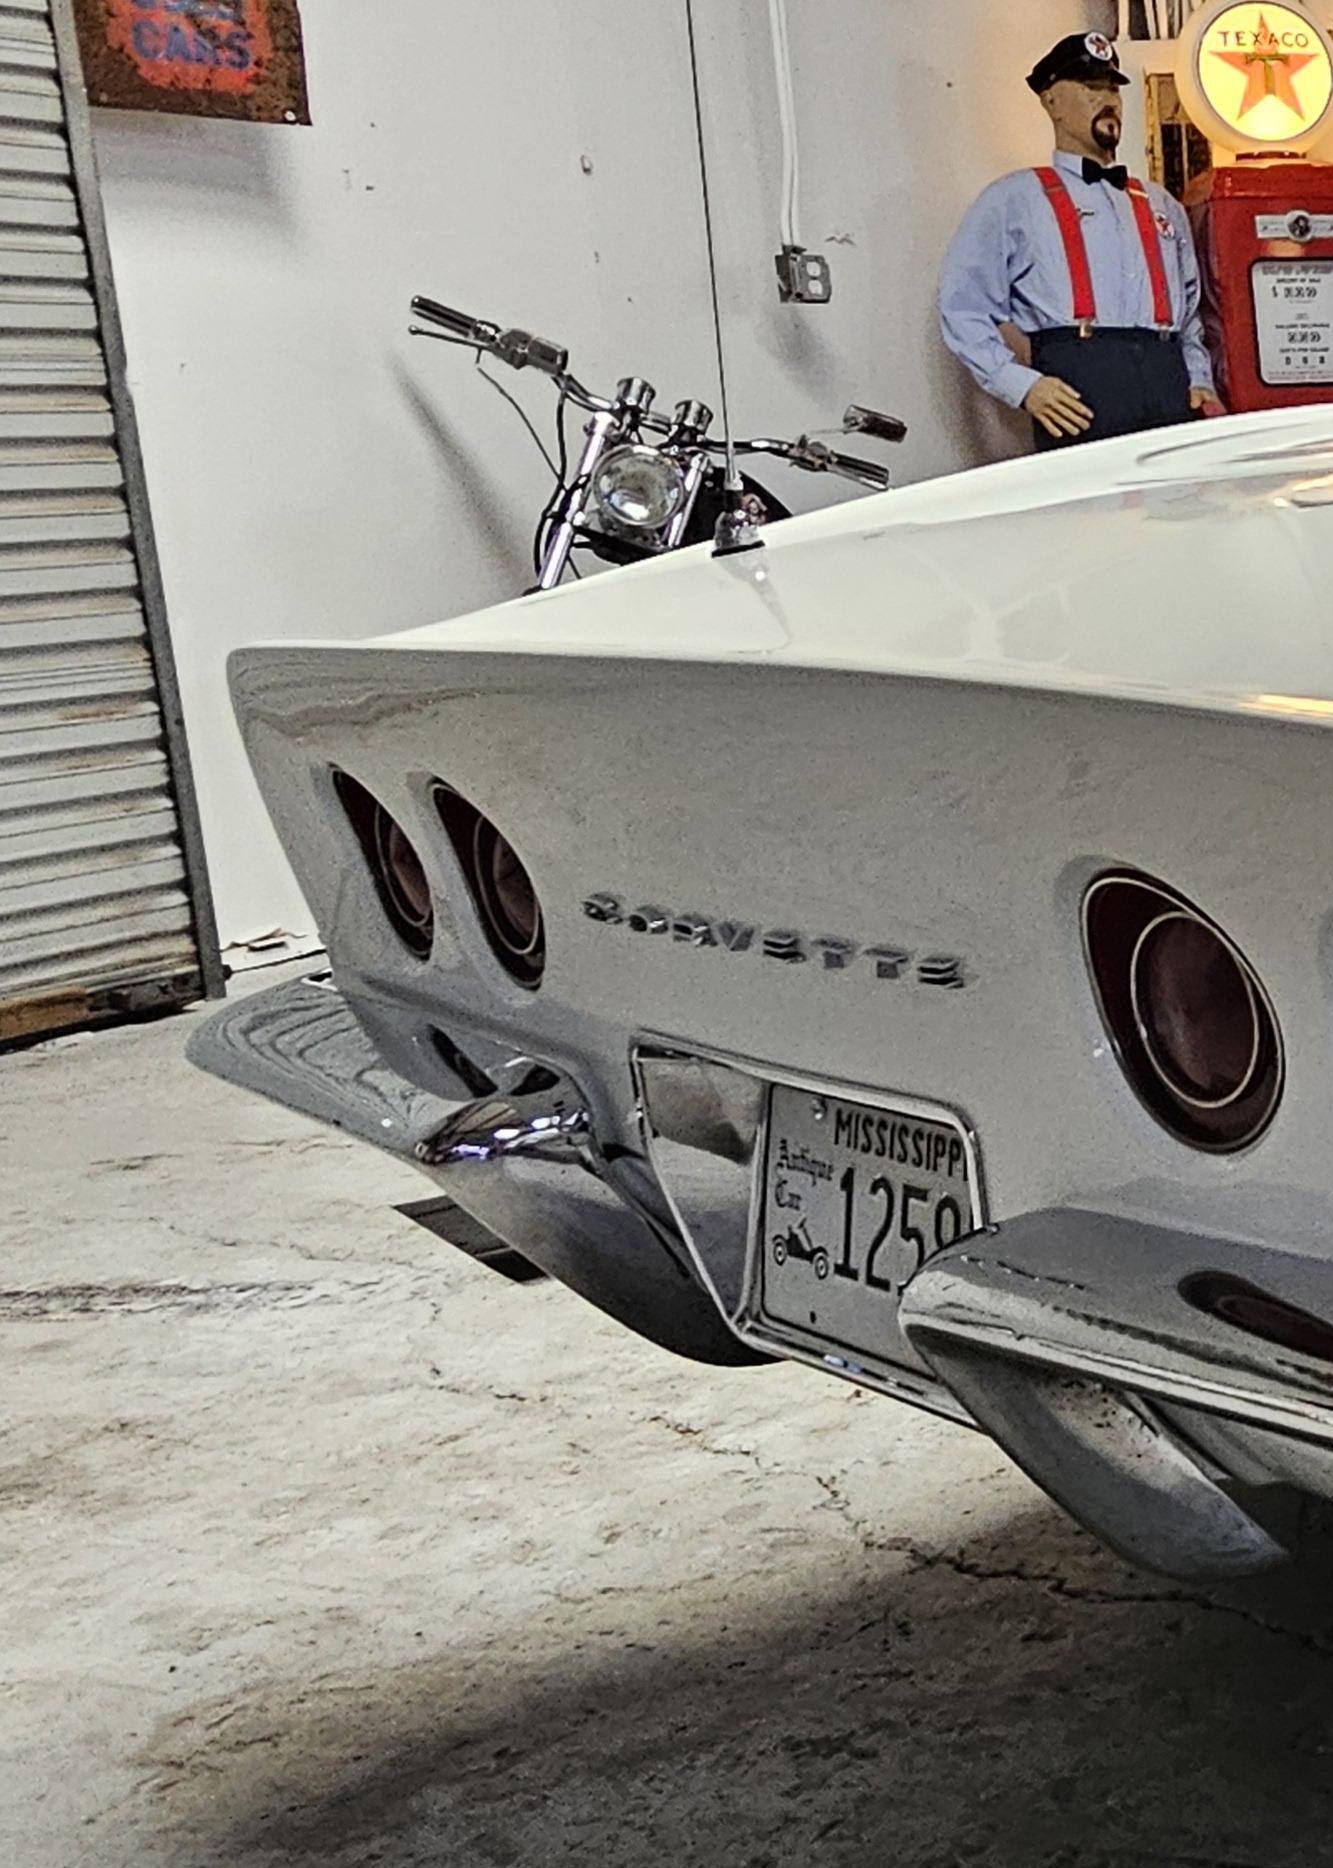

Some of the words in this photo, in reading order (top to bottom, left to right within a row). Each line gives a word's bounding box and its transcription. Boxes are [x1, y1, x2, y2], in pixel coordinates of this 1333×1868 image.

[132, 19, 251, 70] CARS
[1216, 29, 1309, 49] TEXACO
[580, 891, 967, 989] CORVETTE
[776, 1138, 834, 1187] Antique
[774, 1180, 801, 1211] Car
